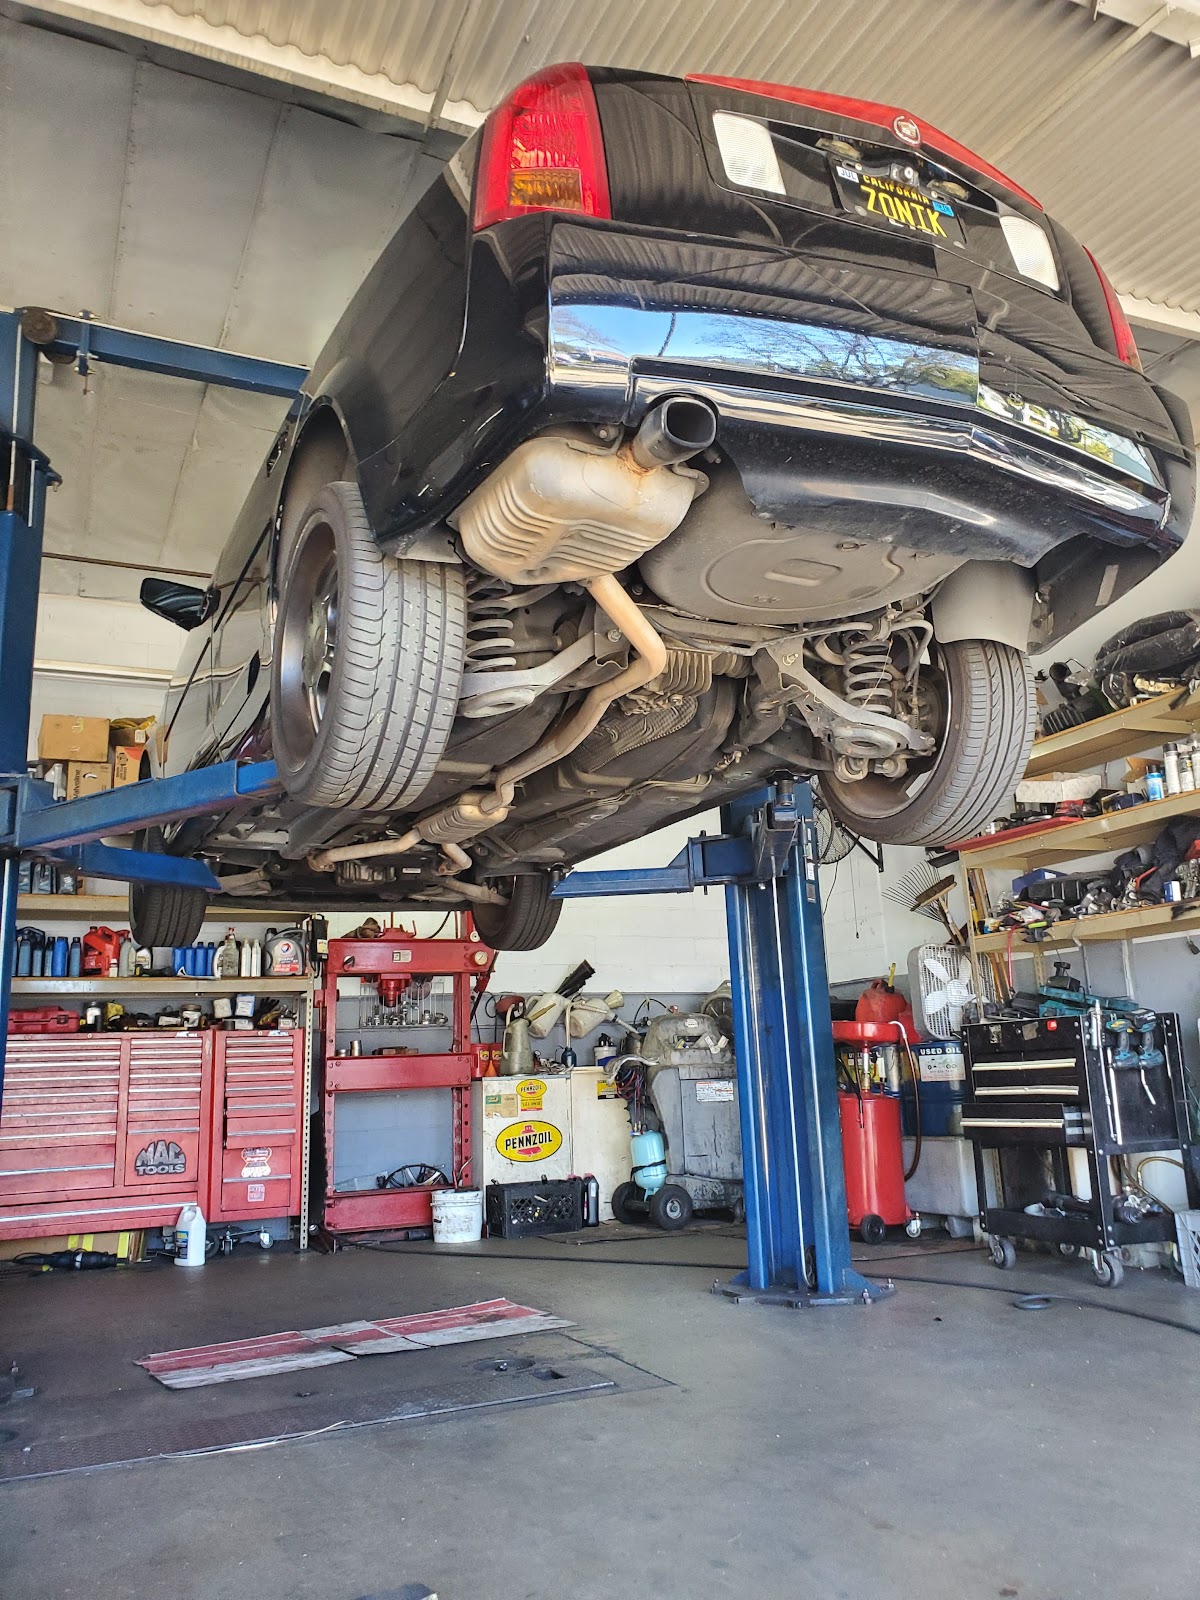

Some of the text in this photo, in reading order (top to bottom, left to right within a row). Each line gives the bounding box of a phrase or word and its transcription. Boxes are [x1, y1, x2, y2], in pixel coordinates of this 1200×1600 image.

[862, 174, 930, 205] CALIFORNIA
[860, 185, 947, 238] ZONIK
[136, 1140, 186, 1166] MAC
[505, 1131, 553, 1151] PENNZOIL
[136, 1164, 185, 1176] TOOLS
